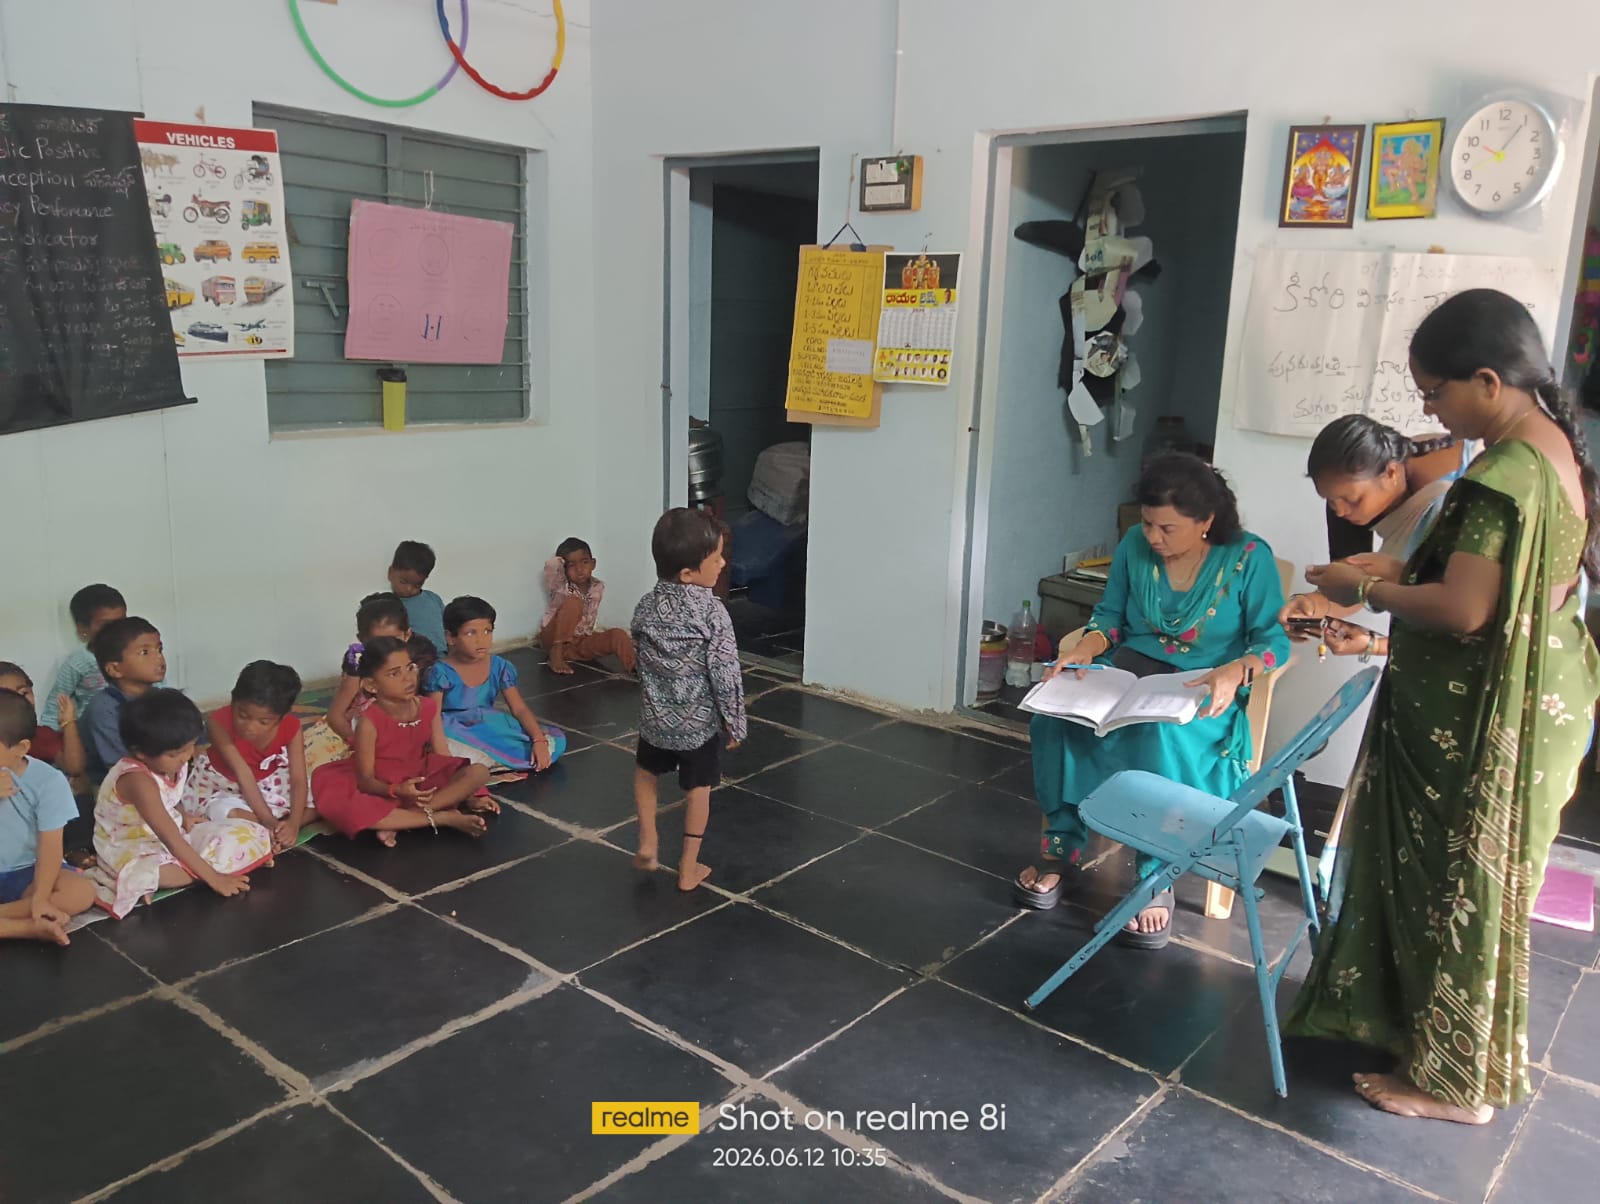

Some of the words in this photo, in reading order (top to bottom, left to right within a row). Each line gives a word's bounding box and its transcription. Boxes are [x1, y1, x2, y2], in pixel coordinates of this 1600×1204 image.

[1499, 109, 1512, 121] 12
[1523, 114, 1528, 127] 1
[1480, 119, 1490, 131] 11
[166, 132, 236, 149] VEHICLES
[1467, 136, 1480, 148] 10
[1530, 130, 1540, 143] 2
[1462, 152, 1470, 164] 9
[1532, 147, 1542, 160] 3
[1463, 169, 1472, 181] 8
[1526, 165, 1535, 177] 4
[1473, 183, 1482, 196] 7
[1513, 182, 1521, 194] 5
[1492, 191, 1501, 202] 6
